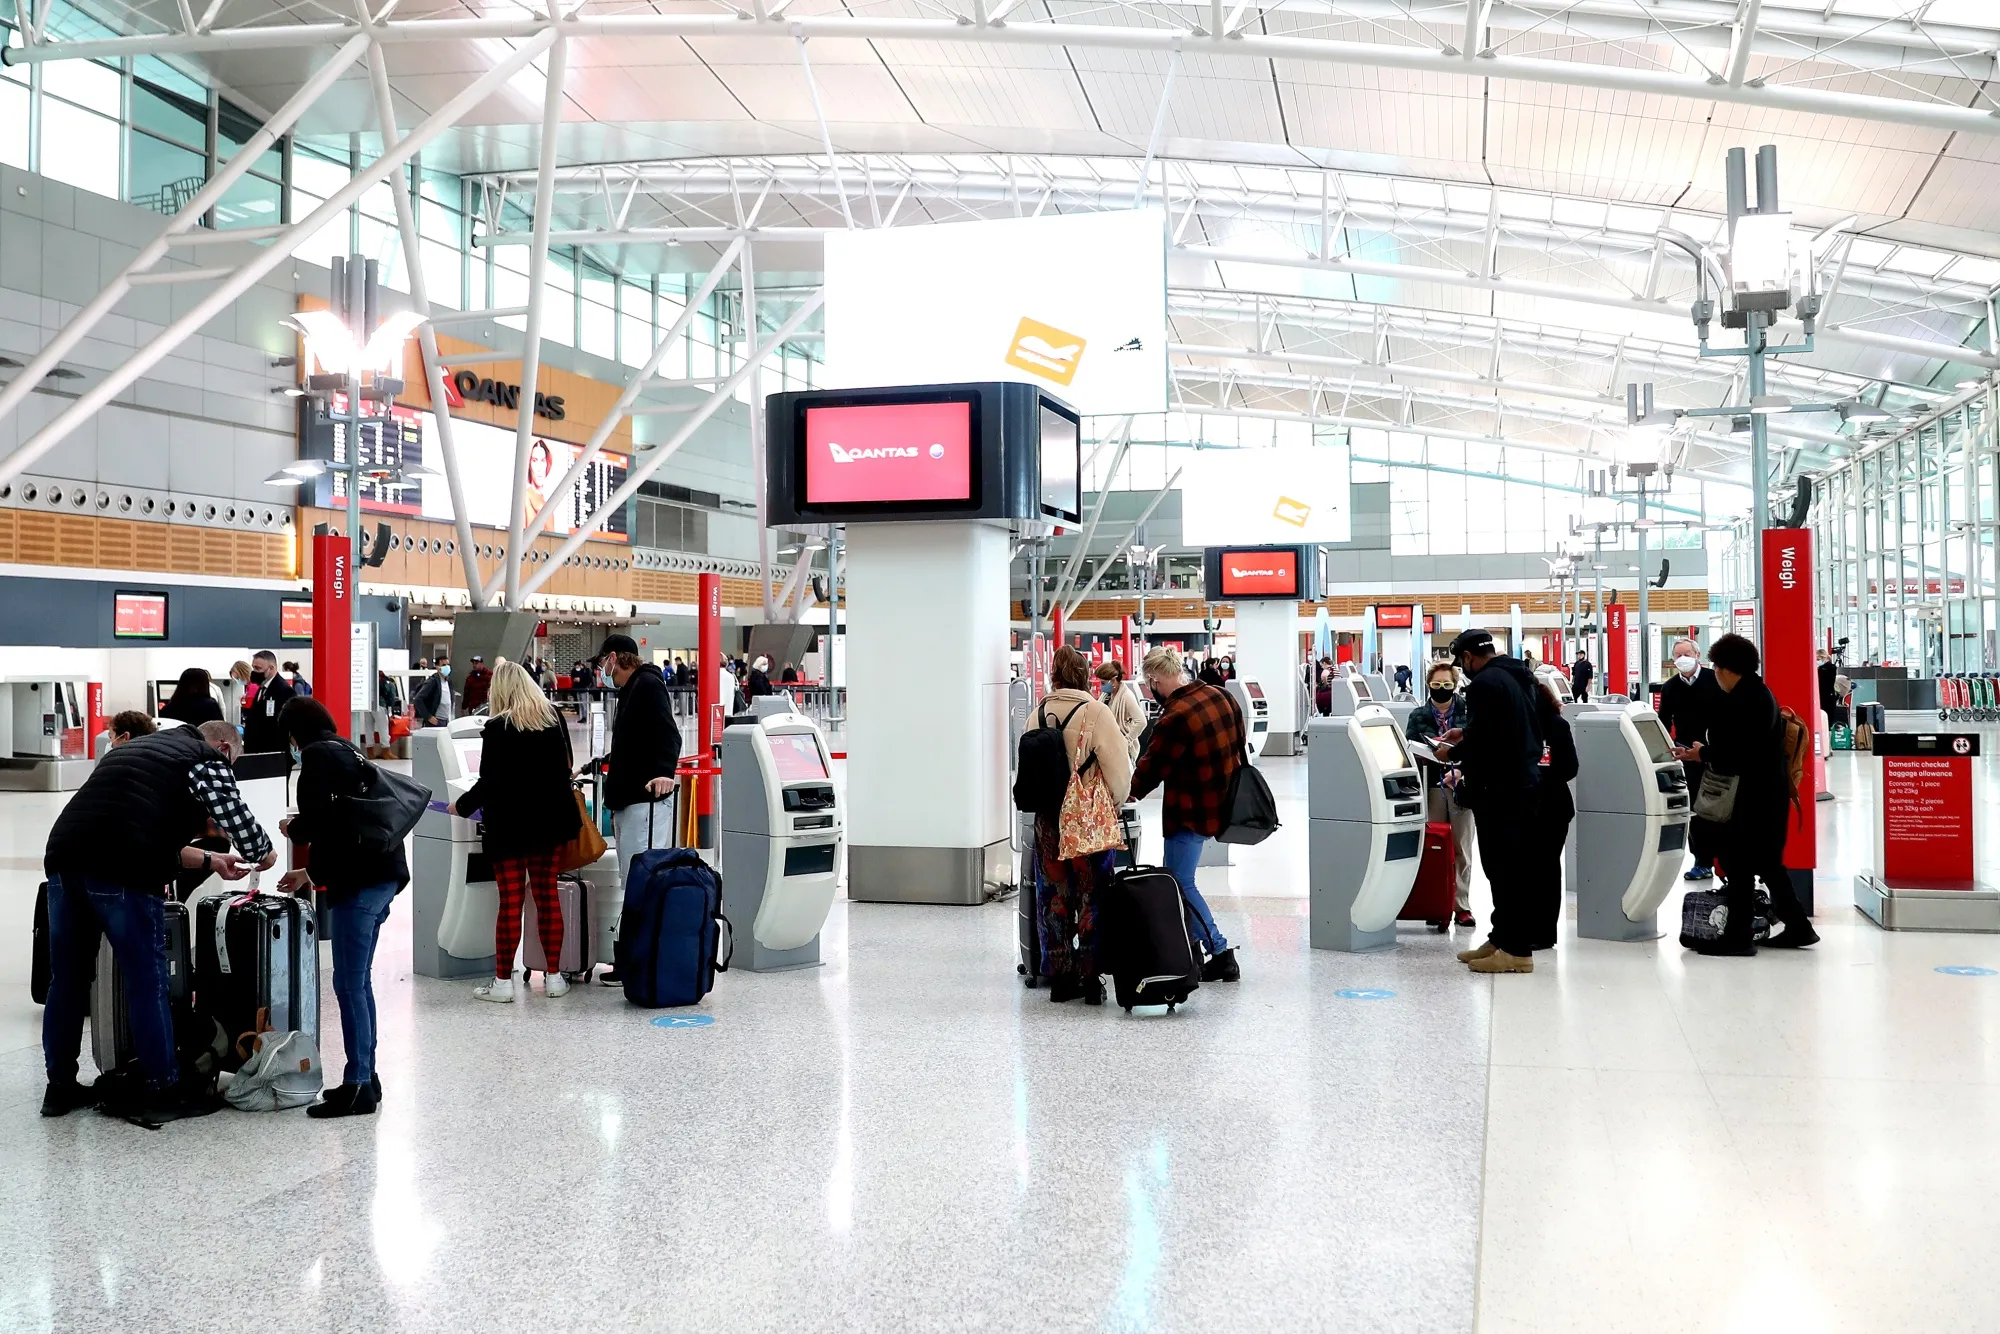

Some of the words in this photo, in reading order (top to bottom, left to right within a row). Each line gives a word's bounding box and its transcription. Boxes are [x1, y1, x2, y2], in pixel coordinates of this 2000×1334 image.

[455, 370, 565, 420] QANAS
[850, 446, 918, 459] QANTAS
[333, 555, 344, 599] Weigh
[1778, 547, 1796, 589] Weigh
[1888, 770, 1918, 778] baggage
